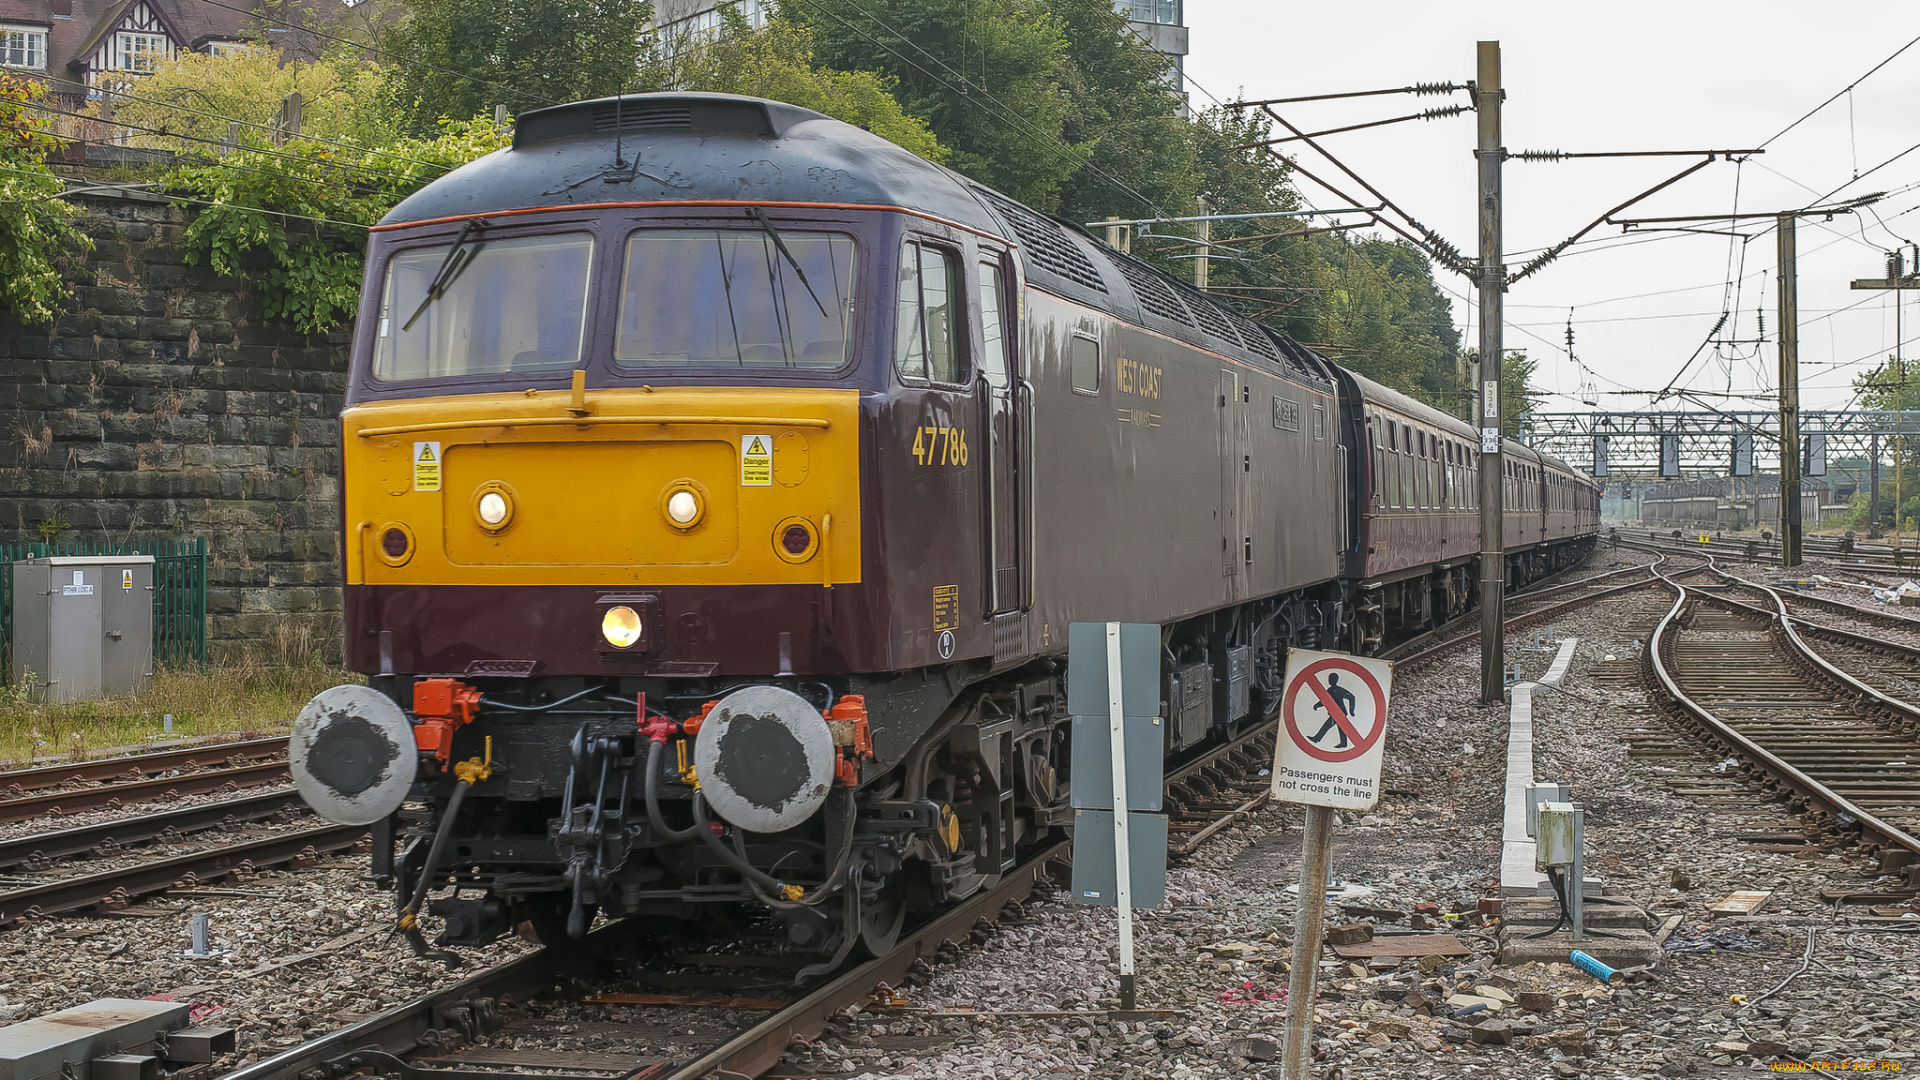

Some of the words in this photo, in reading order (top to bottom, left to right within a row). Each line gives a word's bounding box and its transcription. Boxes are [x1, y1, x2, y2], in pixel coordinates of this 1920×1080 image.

[1116, 357, 1137, 394] WEST
[1139, 363, 1162, 400] COAST
[912, 426, 968, 467] 47786
[743, 457, 770, 466] Danger
[1280, 766, 1343, 783] Passengers
[1346, 776, 1373, 788] must
[1279, 780, 1297, 790] not
[1300, 783, 1330, 794] cross
[1333, 785, 1351, 797] the
[1353, 788, 1372, 800] line
